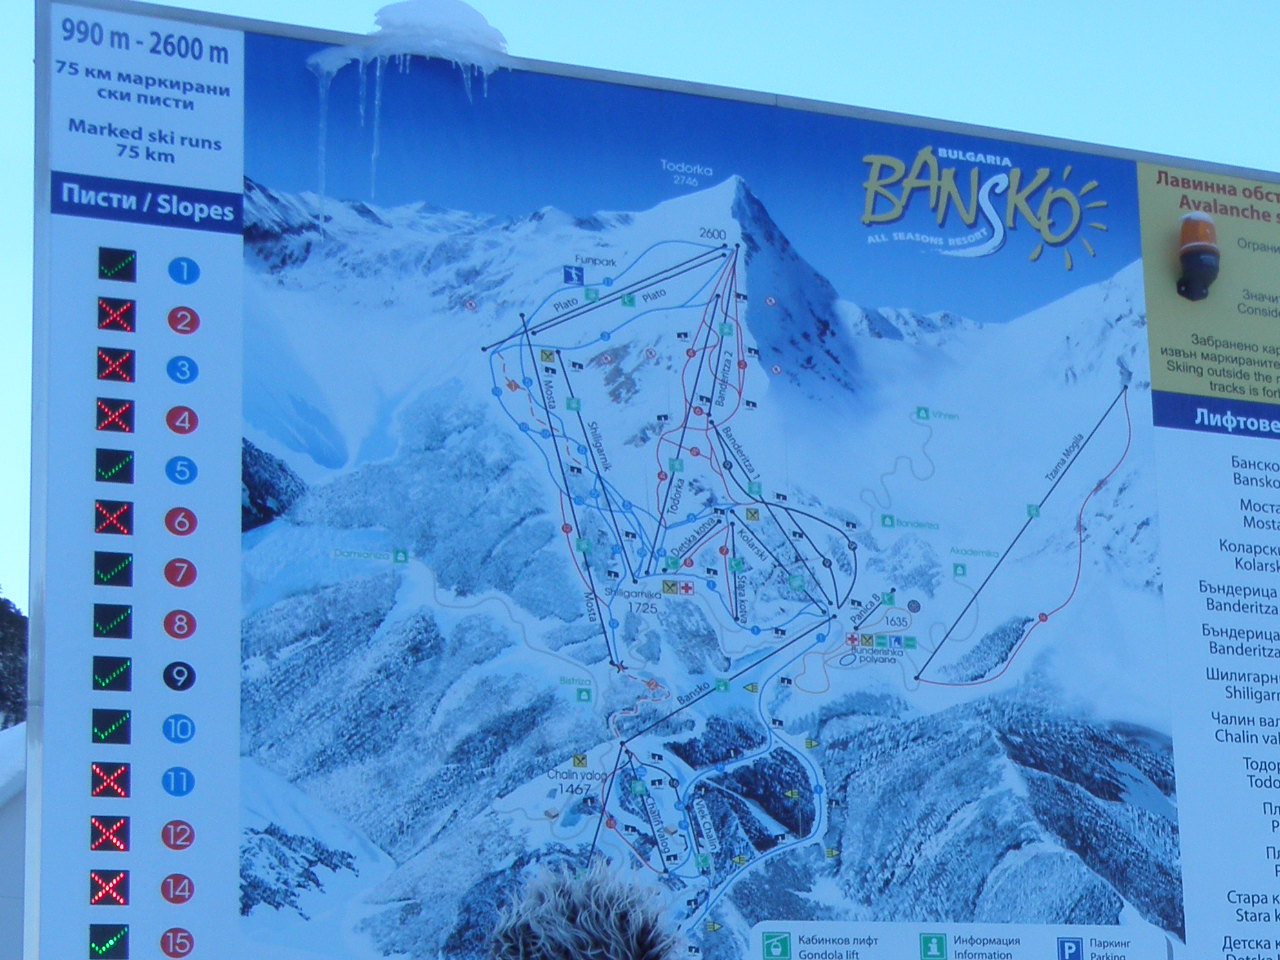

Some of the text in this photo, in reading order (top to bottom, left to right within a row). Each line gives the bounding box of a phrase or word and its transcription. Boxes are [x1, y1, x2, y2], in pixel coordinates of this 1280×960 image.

[62, 18, 228, 64] 990 m 2600 m
[56, 60, 230, 97] 75 км маркирани
[98, 88, 194, 110] ски писти
[69, 118, 222, 150] Marked ski runs
[117, 144, 175, 163] 75 km
[938, 147, 1012, 167] BULGARIA
[661, 159, 713, 177] Todorka
[673, 175, 698, 186] 2746
[1156, 171, 1237, 197] Лавинна
[63, 182, 234, 222] Писти Slopes
[861, 145, 1081, 251] BANSKO
[1179, 195, 1271, 222] Avalanche
[700, 228, 726, 240] 2600
[575, 255, 617, 267] Funpark
[181, 261, 188, 281] 1
[642, 288, 667, 303] Plato
[553, 298, 579, 313] Plato
[177, 311, 190, 331] 2
[176, 361, 190, 380] 3
[1166, 360, 1204, 377] Skiing
[1207, 366, 1250, 381] outside
[1254, 370, 1272, 383] the
[1210, 381, 1245, 395] tracks
[1250, 386, 1259, 395] is
[175, 412, 190, 431] 4
[175, 461, 189, 481] 5
[1231, 456, 1280, 472] Банско
[1234, 473, 1280, 489] Bansko
[174, 512, 189, 531] 6
[737, 528, 768, 562] Kolarski
[175, 563, 188, 583] 7
[1199, 580, 1277, 600] Бъндерица
[628, 603, 658, 614] 1725
[850, 601, 874, 624] Panica
[1206, 598, 1279, 616] Banderitza
[174, 614, 188, 635] 8
[885, 616, 908, 626] 1635
[173, 666, 188, 686] 9
[677, 682, 710, 705] Bansko
[1212, 711, 1255, 726] Чалин
[168, 718, 191, 739] 10
[1215, 730, 1258, 744] Chalin
[167, 771, 187, 792] 11
[547, 770, 607, 783] Chalin valog
[558, 784, 591, 795] 1467
[167, 825, 190, 845] 12
[166, 879, 190, 899] 14
[166, 932, 190, 953] 15
[798, 935, 879, 947] Кабинков лифт
[954, 936, 1020, 946] Информация
[1090, 938, 1130, 949] Паркинг
[799, 950, 859, 960] Gondola lift
[955, 950, 1012, 960] Information
